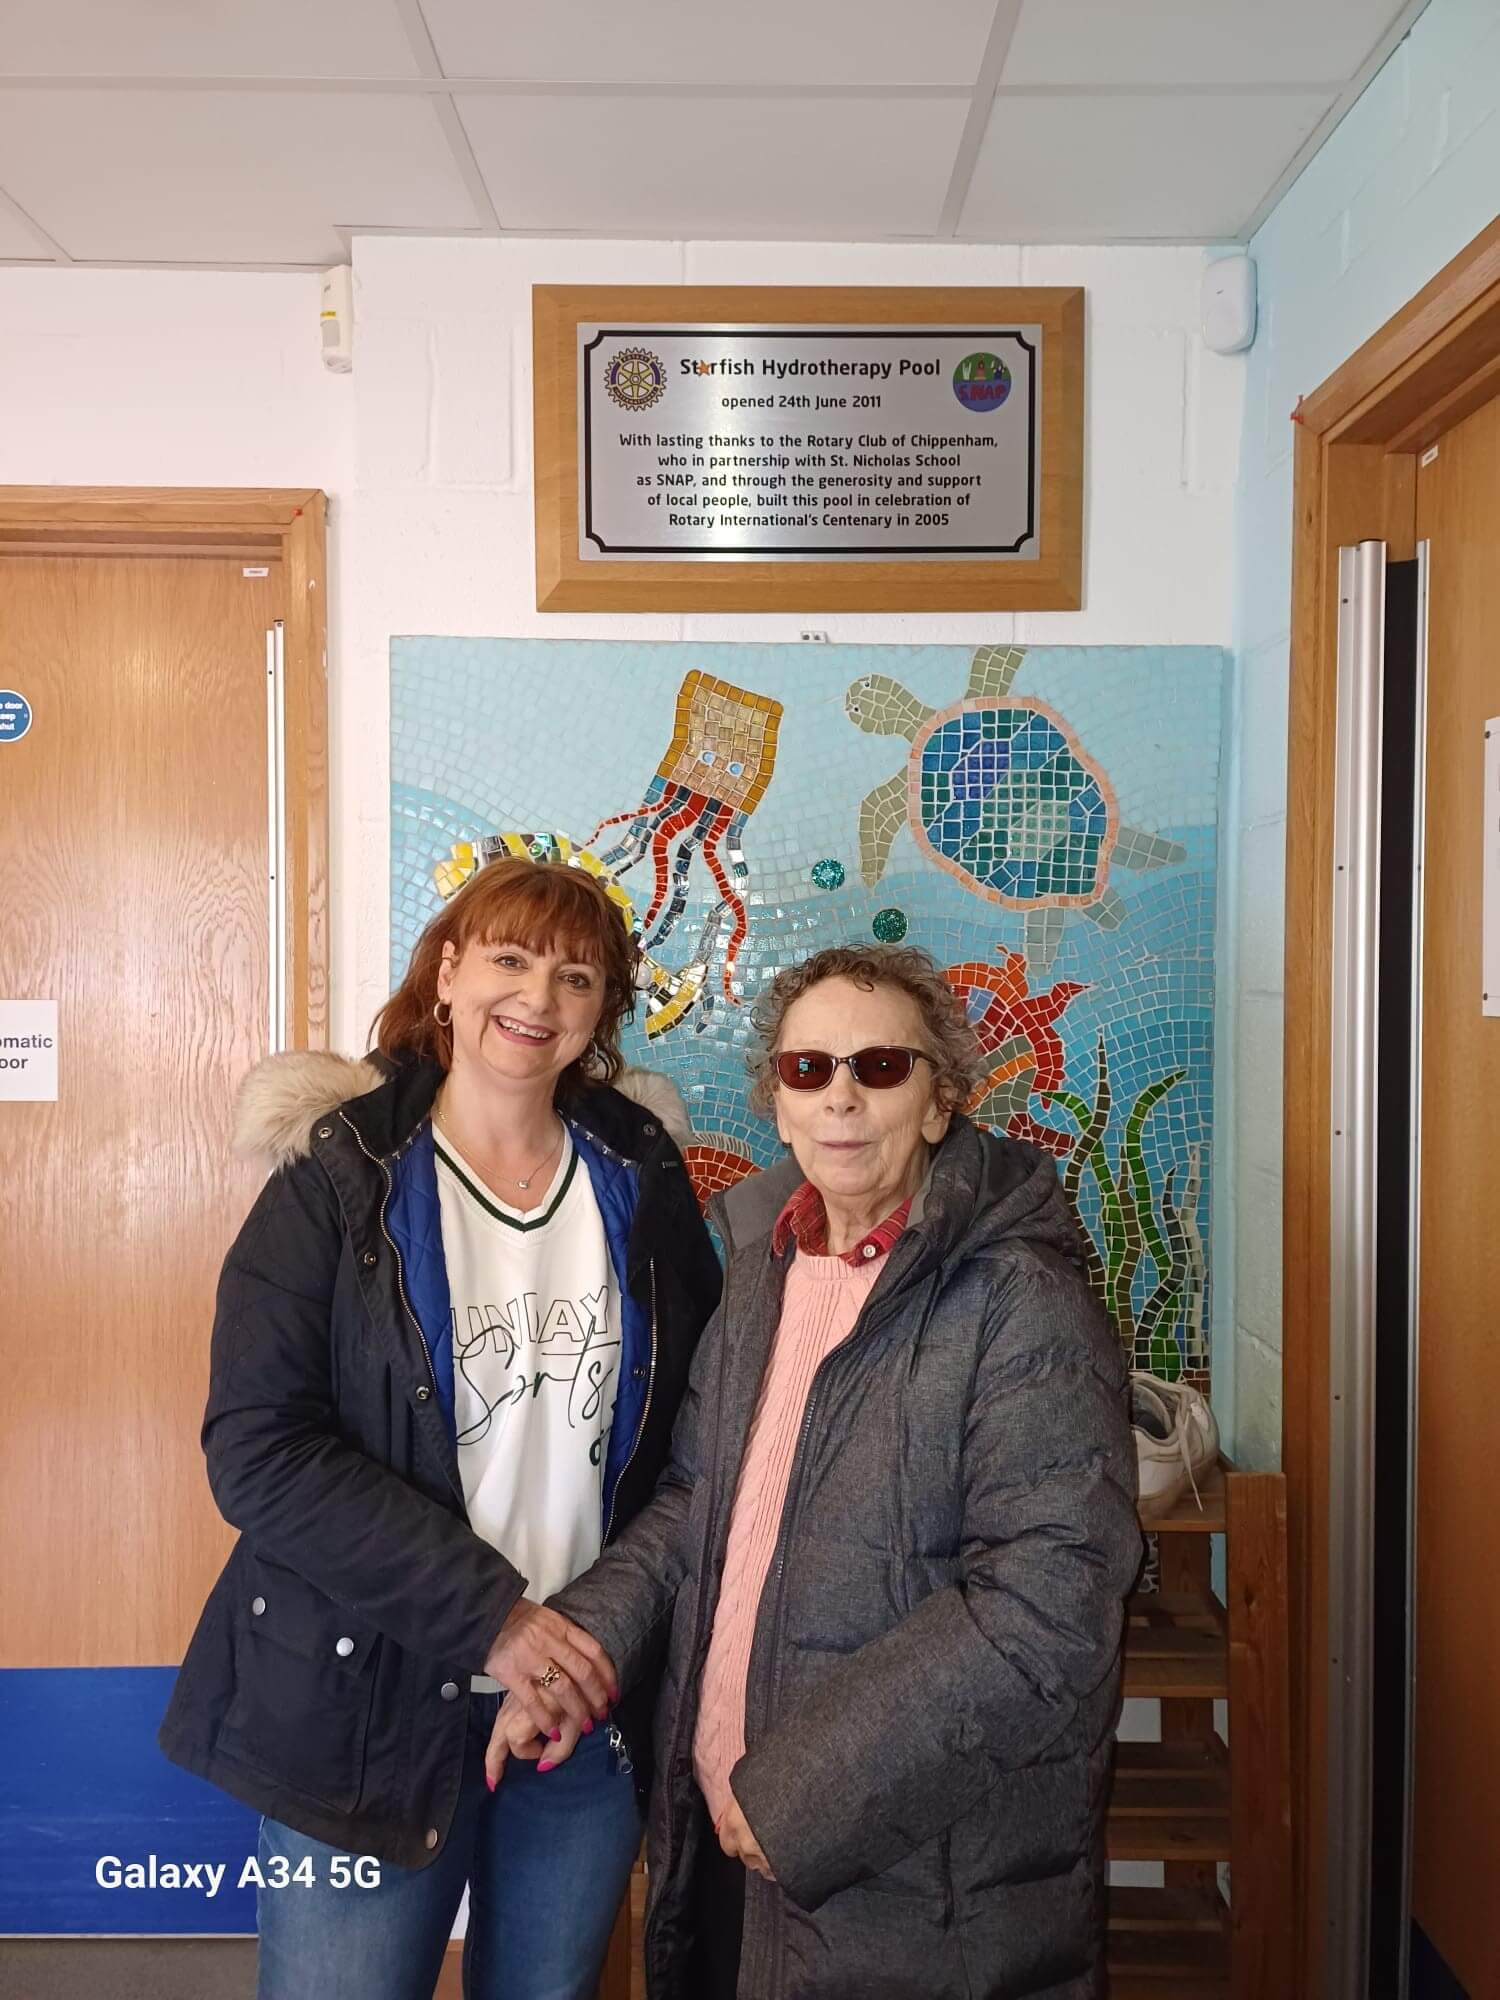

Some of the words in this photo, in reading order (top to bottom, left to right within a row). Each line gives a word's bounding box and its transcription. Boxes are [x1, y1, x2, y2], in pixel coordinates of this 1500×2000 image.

[679, 357, 755, 376] Strfish
[762, 357, 893, 380] Hydrotherapy
[899, 357, 941, 376] Pool
[721, 394, 775, 410] opened
[778, 394, 811, 408] 24th
[814, 394, 848, 410] June
[851, 394, 881, 408] 2011
[619, 433, 652, 448] With
[656, 433, 704, 450] lasting
[707, 433, 756, 448] thanks
[759, 435, 775, 448] to
[778, 433, 803, 448] the
[806, 433, 854, 450] Rotary
[856, 433, 888, 448] Club
[891, 433, 907, 448] of
[910, 433, 998, 450] Chippenham,
[657, 453, 688, 467] who
[691, 453, 705, 467] in
[709, 453, 791, 470] partnership
[794, 453, 827, 467] with
[829, 453, 849, 467] St.
[852, 453, 911, 467] Nicholas
[914, 453, 961, 467] School
[636, 476, 652, 487] as
[656, 473, 697, 489] SNAP,
[701, 473, 727, 487] and
[731, 473, 787, 489] through
[790, 473, 815, 487] the
[818, 473, 893, 489] generosity
[896, 473, 923, 487] and
[927, 473, 982, 489] support
[647, 493, 662, 507] of
[665, 493, 698, 507] local
[702, 493, 752, 509] people,
[756, 493, 789, 507] built
[791, 493, 820, 507] this
[822, 493, 853, 509] pool
[857, 493, 871, 507] in
[874, 493, 952, 507] celebration
[954, 493, 971, 507] of
[668, 512, 716, 528] Rotary
[719, 512, 819, 526] International's
[822, 512, 893, 528] Centenary
[896, 512, 910, 526] in
[914, 512, 950, 526] 2005
[0, 1034, 53, 1048] matic
